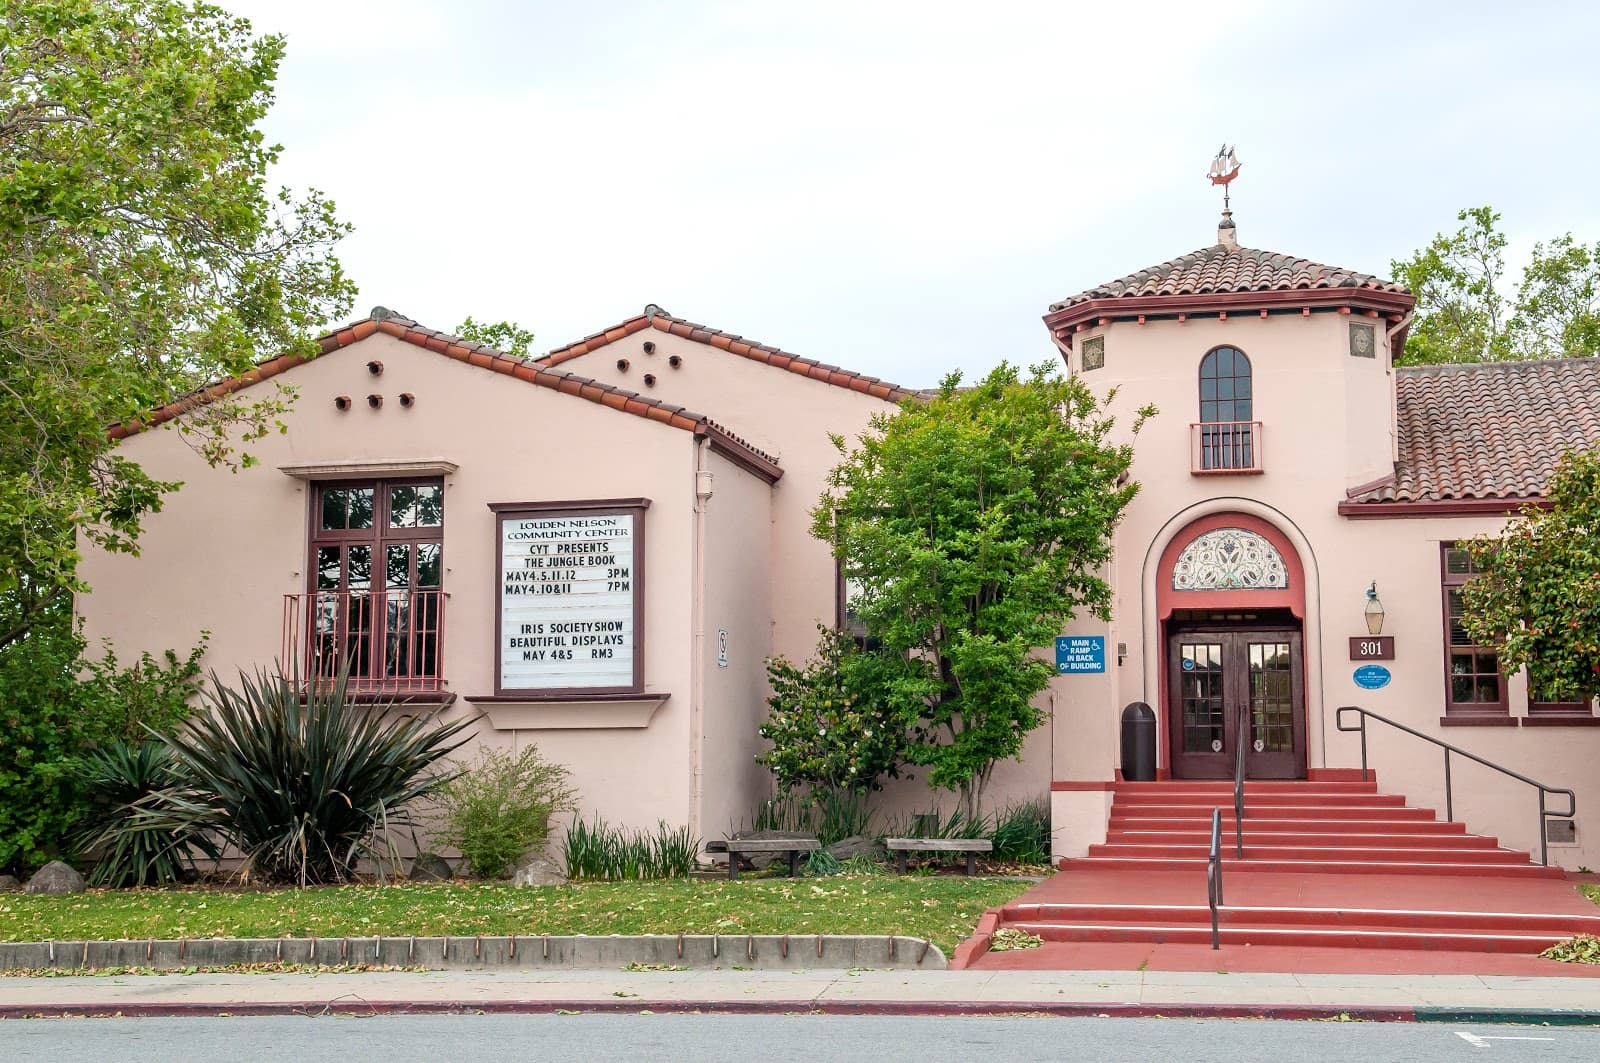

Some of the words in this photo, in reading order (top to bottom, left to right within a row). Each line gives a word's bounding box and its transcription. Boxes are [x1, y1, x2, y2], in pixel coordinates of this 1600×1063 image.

[520, 521, 566, 530] LOUDEN
[570, 519, 616, 528] NELSON
[507, 530, 581, 540] COMMUNITY
[584, 528, 629, 537] CENTER
[530, 545, 549, 554] CYT
[557, 542, 609, 553] PRESENTS
[525, 558, 543, 568] THE
[546, 557, 584, 567] JUNGLE
[588, 555, 615, 565] BOOK
[521, 624, 544, 634] IRIS
[510, 637, 566, 648] BEAUTIFUL
[572, 635, 624, 646] DISPLAYS
[1360, 641, 1382, 655] 301
[523, 650, 545, 660] MAY
[550, 650, 573, 660] 4&5
